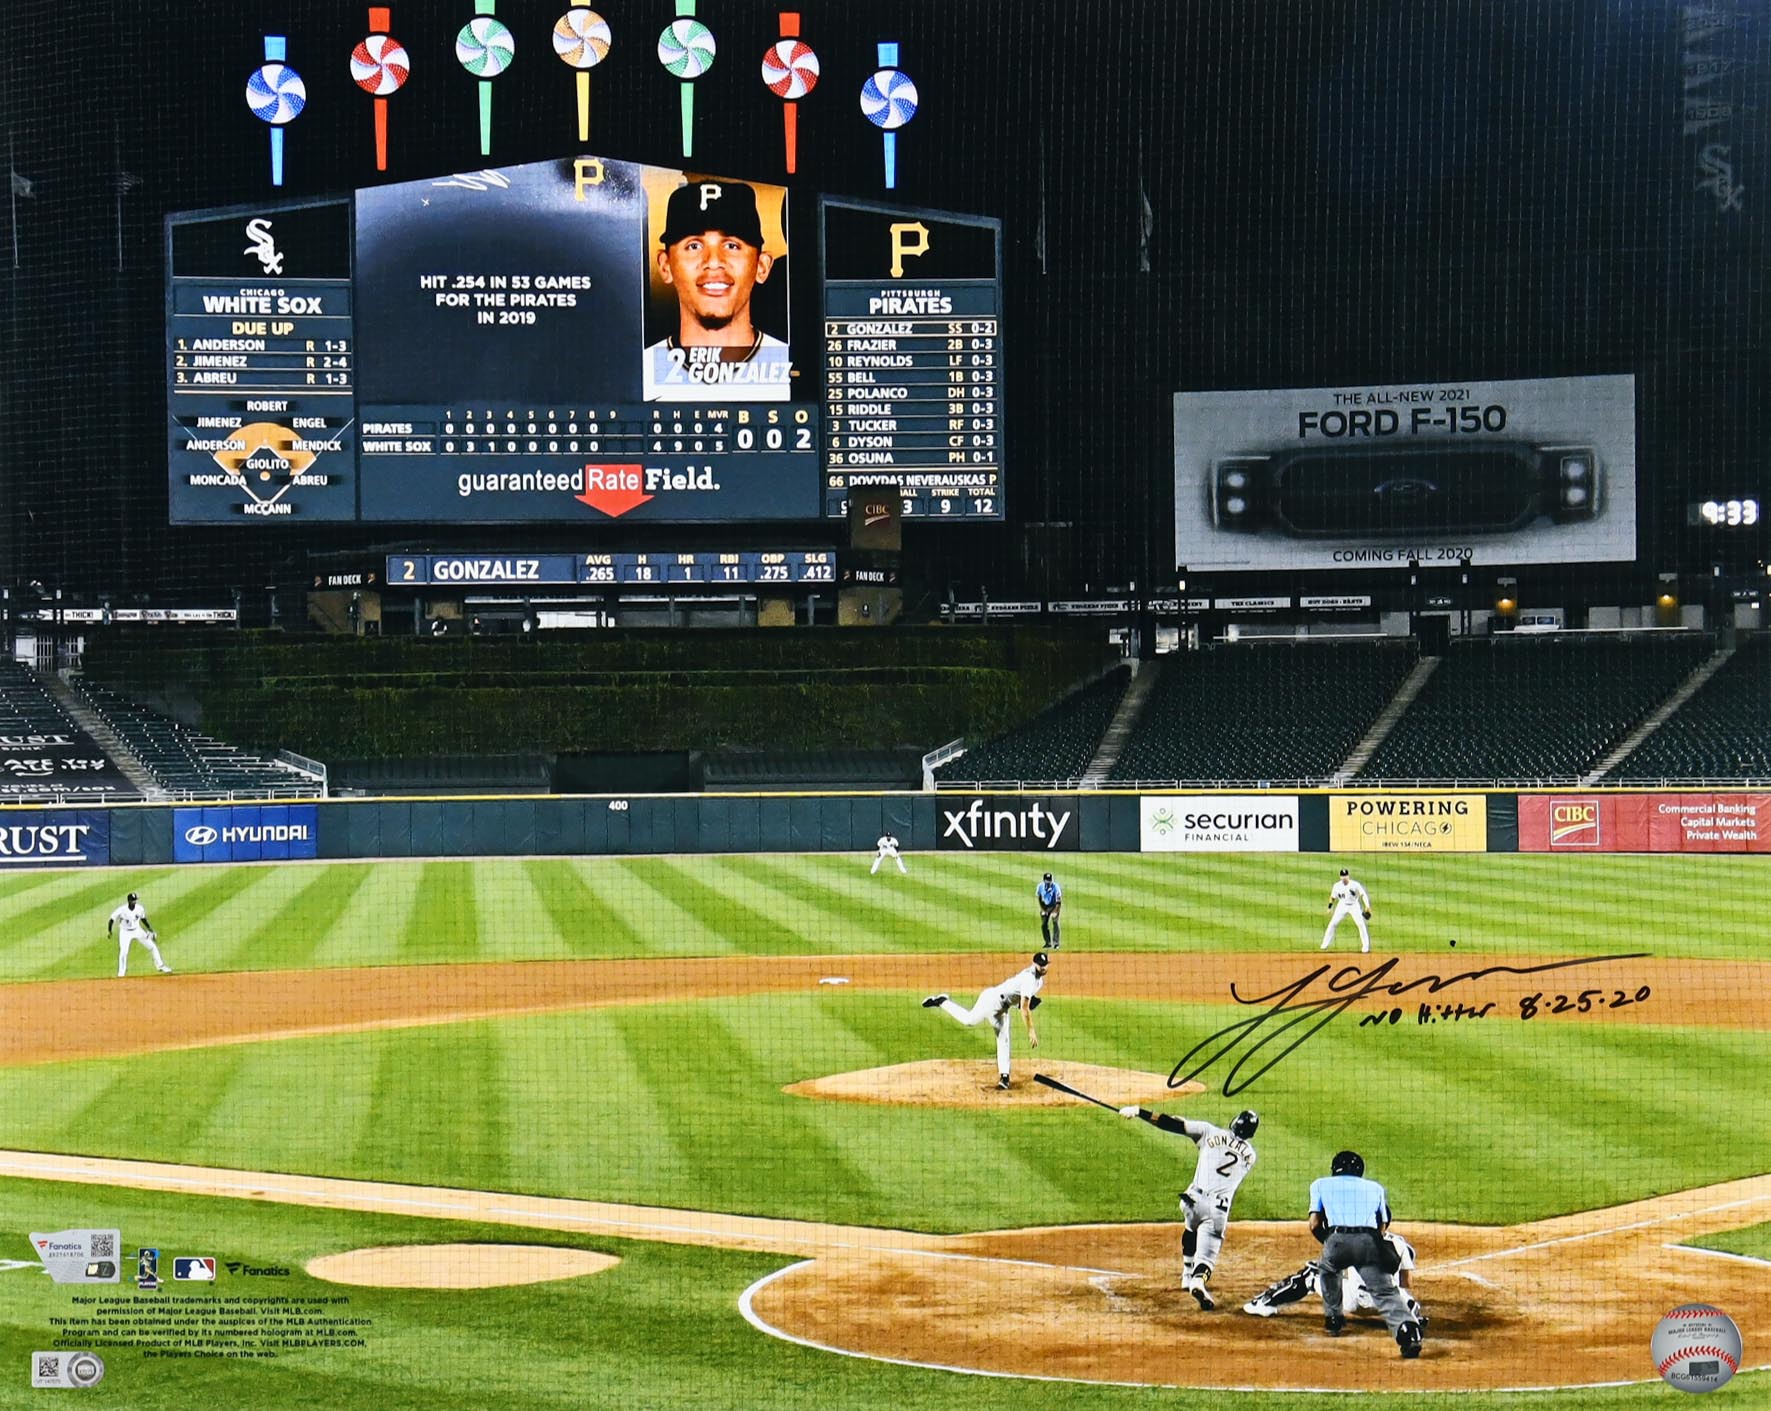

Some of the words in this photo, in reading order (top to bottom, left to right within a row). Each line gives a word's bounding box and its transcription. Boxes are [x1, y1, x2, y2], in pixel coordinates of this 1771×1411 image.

[573, 159, 604, 201] P
[699, 184, 722, 211] P
[889, 221, 930, 278] P
[420, 275, 446, 289] HIT
[452, 275, 485, 289] .254
[490, 275, 507, 289] IN
[512, 275, 531, 289] 53
[535, 275, 591, 289] GAMES
[240, 288, 285, 297] CHICAGO
[203, 296, 272, 315] WHITE
[278, 296, 322, 314] SOX
[436, 293, 469, 307] FOR
[474, 293, 505, 307] THE
[510, 293, 577, 307] PIRATES
[869, 297, 953, 315] PIRATES
[477, 311, 494, 325] IN
[499, 311, 536, 325] 2019
[232, 321, 267, 336] DUE
[272, 321, 294, 336] UP
[831, 325, 839, 335] 2
[847, 323, 913, 335] GONZALEZ
[948, 323, 963, 334] SS
[971, 323, 992, 334] 0-2
[177, 339, 188, 350] 1.
[193, 339, 265, 351] ANDERSON
[306, 341, 315, 352] R
[325, 341, 347, 352] 1-3
[827, 340, 843, 351] 26
[847, 339, 897, 351] FRAZIER
[948, 339, 963, 350] 2B
[971, 338, 993, 349] 0-3
[176, 355, 188, 367] 2.
[193, 355, 247, 367] JIMENEZ
[306, 357, 315, 368] R
[323, 357, 347, 368] 2-4
[689, 347, 722, 363] ERIK
[828, 356, 843, 367] 10
[847, 355, 913, 367] REYNOLDS
[949, 355, 963, 366] LF
[971, 355, 993, 366] 0-3
[664, 348, 686, 384] 2
[688, 362, 793, 384] GONZALEZ
[176, 372, 188, 384] 3.
[193, 372, 237, 384] ABREU
[306, 374, 315, 385] R
[325, 373, 347, 385] 1-3
[828, 372, 843, 383] 55
[847, 371, 876, 383] BELL
[949, 371, 964, 382] 1B
[972, 371, 993, 382] 0-3
[828, 388, 843, 399] 25
[847, 387, 908, 399] POLANCO
[948, 387, 965, 398] DH
[972, 387, 993, 398] 0-3
[1333, 393, 1362, 405] THE
[1366, 390, 1434, 404] ALL-NEW
[1439, 389, 1470, 401] 2021
[247, 401, 287, 412] ROBERT
[829, 404, 843, 416] 15
[847, 403, 892, 415] RIDDLE
[949, 403, 964, 414] 3B
[972, 403, 993, 414] 0-3
[197, 416, 242, 428] JIMENEZ
[293, 417, 327, 429] ENGEL
[738, 411, 749, 424] B
[768, 410, 778, 424] S
[795, 410, 808, 424] O
[1299, 409, 1399, 438] FORD
[1411, 405, 1506, 435] F-150
[362, 423, 413, 434] PIRATES
[832, 420, 840, 431] 3
[848, 419, 897, 431] TUCKER
[949, 419, 964, 430] RF
[972, 419, 993, 430] 0-3
[186, 439, 246, 451] ANDERSON
[737, 428, 753, 449] 0
[766, 428, 782, 449] 0
[796, 428, 811, 449] 2
[292, 440, 341, 451] MENDICK
[362, 441, 402, 452] WHITE
[405, 441, 432, 452] SOX
[246, 458, 289, 470] GIOLITO
[190, 474, 247, 486] MONCADA
[292, 474, 328, 486] ABREU
[458, 468, 583, 497] guaranteed
[588, 468, 640, 490] Rate
[645, 466, 721, 490] Field.
[829, 475, 844, 487] 66
[906, 474, 985, 486] NEVERAUSKAS
[990, 474, 997, 485] P
[932, 488, 960, 497] STRIKE
[968, 487, 996, 496] TOTAL
[244, 504, 291, 515] MCCANN
[865, 504, 889, 515] CIBC
[586, 554, 611, 565] AVG
[638, 554, 647, 565] H
[678, 554, 694, 564] HR
[720, 554, 739, 564] RBI
[761, 553, 785, 564] OBP
[804, 553, 827, 564] SLG
[1333, 550, 1393, 562] COMING
[1398, 549, 1432, 561] FALL
[1437, 547, 1473, 560] 2020
[403, 561, 415, 580] 2
[433, 560, 539, 580] GONZALEZ
[586, 567, 614, 580] .265
[635, 567, 651, 580] 18
[684, 567, 691, 580] 1
[724, 567, 739, 580] 11
[760, 566, 788, 580] .275
[803, 566, 831, 580] .412
[856, 570, 869, 581] FAN
[869, 570, 884, 582] DECK
[328, 575, 342, 586] FAN
[343, 574, 361, 585] DECK
[608, 800, 629, 811] 400
[1347, 801, 1469, 816] POWERING
[1658, 803, 1715, 814] Commercial
[1717, 803, 1756, 816] Banking
[1184, 810, 1294, 830] securian
[1554, 807, 1595, 822] CIBC
[944, 800, 1071, 848] xfinity
[1680, 816, 1713, 828] Capital
[1716, 817, 1756, 827] Markets
[222, 825, 309, 842] HYUNDAI
[1185, 833, 1248, 842] FINANCIAL
[1686, 830, 1719, 840] Private
[1722, 830, 1757, 840] Wealth
[1216, 1151, 1238, 1178] 2
[49, 1242, 81, 1250] Fanatics
